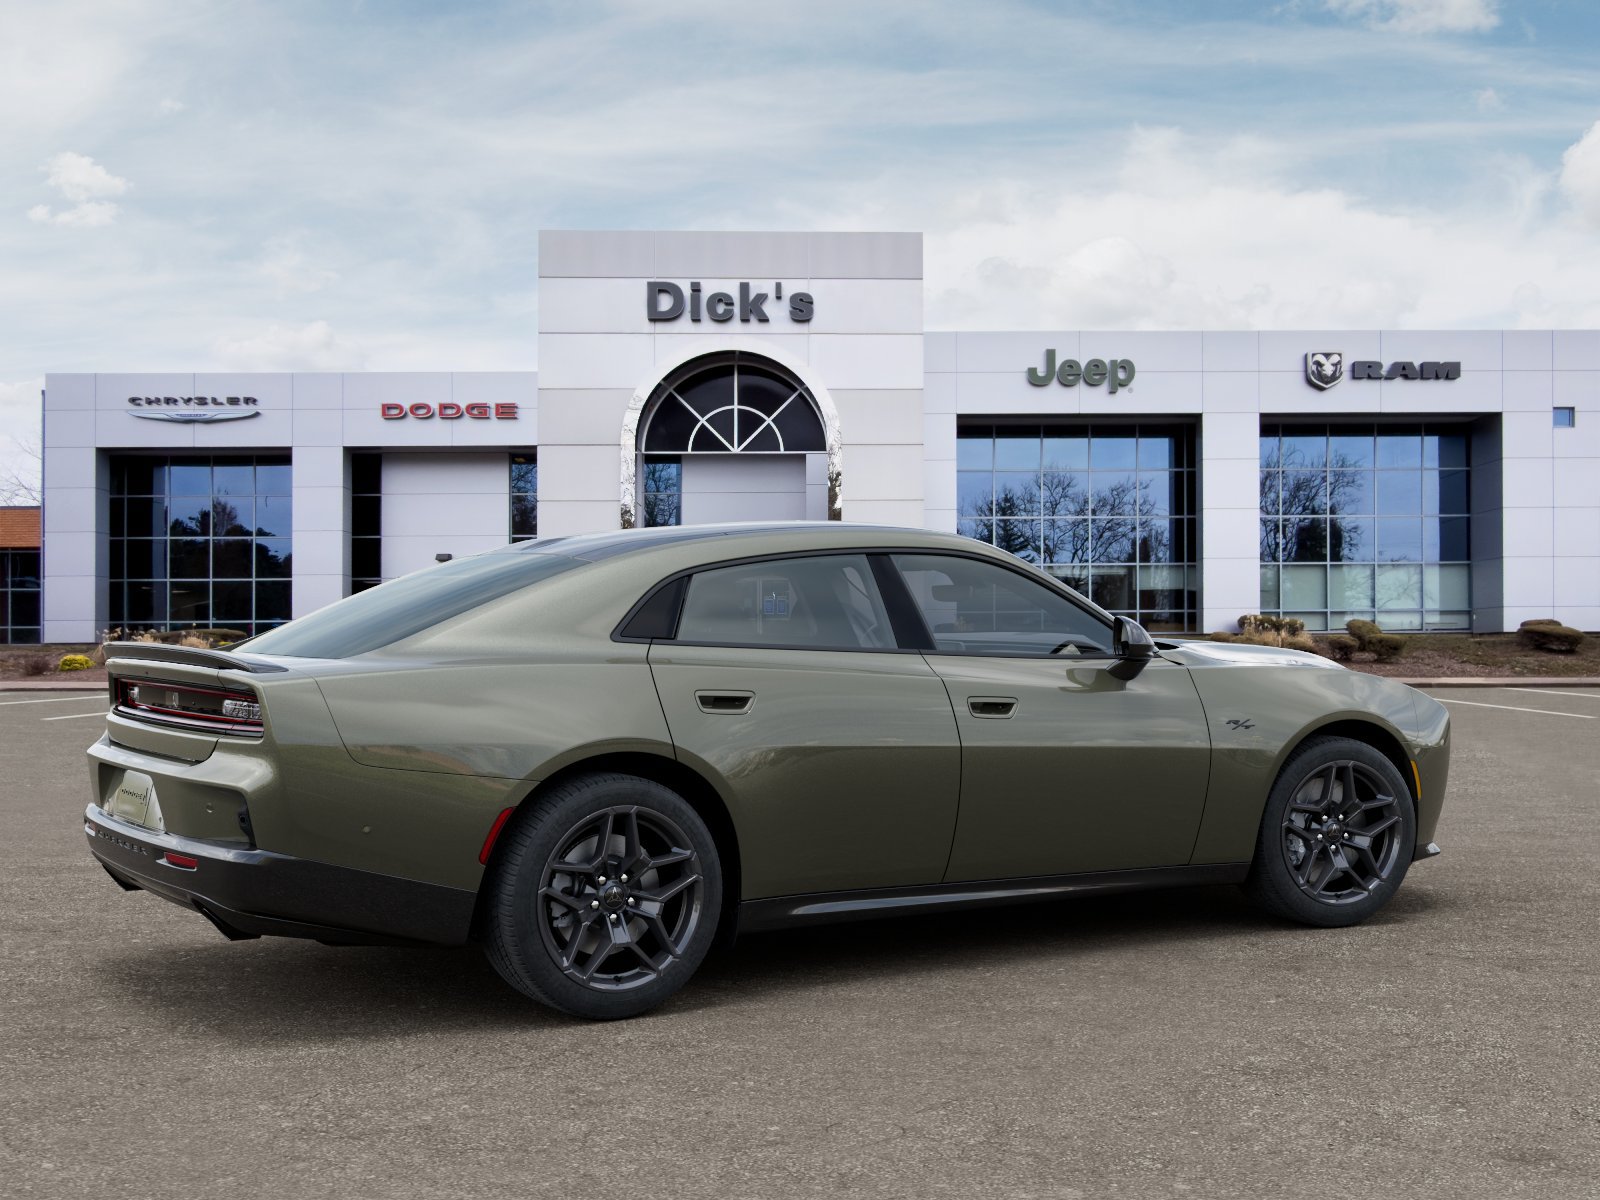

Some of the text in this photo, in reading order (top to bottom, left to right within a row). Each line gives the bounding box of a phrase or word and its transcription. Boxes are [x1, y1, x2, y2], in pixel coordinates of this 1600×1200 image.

[646, 281, 815, 322] Dick's
[1027, 348, 1136, 394] Jeep
[1352, 360, 1461, 380] RAM
[128, 396, 258, 407] CHRYSLER
[381, 402, 518, 420] DODGE
